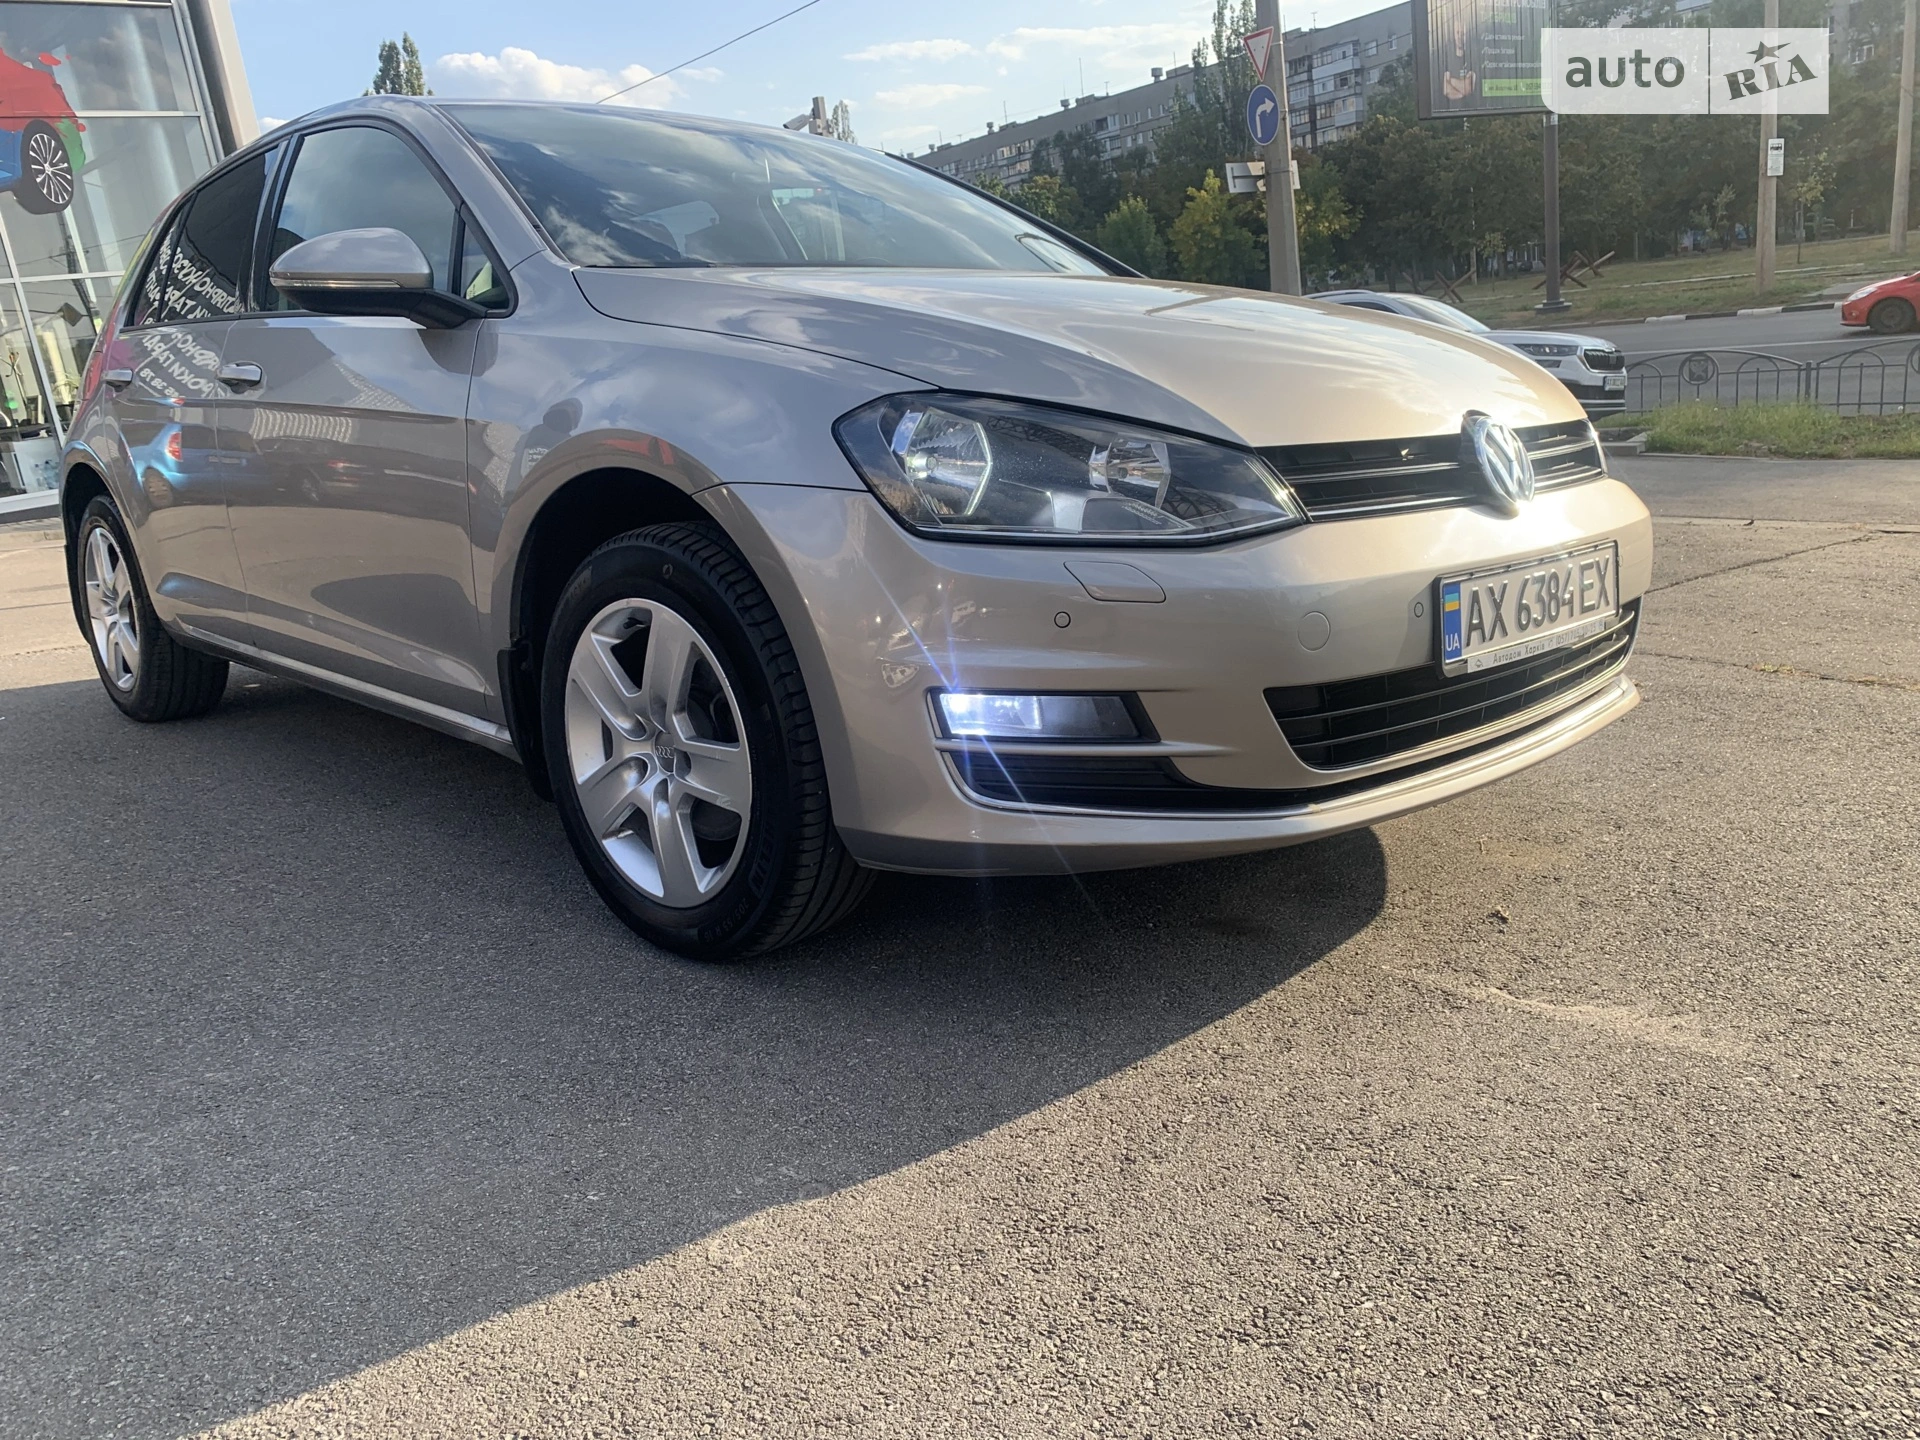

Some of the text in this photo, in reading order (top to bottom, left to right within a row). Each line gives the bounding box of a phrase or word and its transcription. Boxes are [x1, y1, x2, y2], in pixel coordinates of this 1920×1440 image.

[1466, 555, 1611, 647] AX 6384 EX
[1445, 632, 1461, 652] UA
[1493, 651, 1522, 665] Автодом
[1524, 643, 1545, 656] Харків
